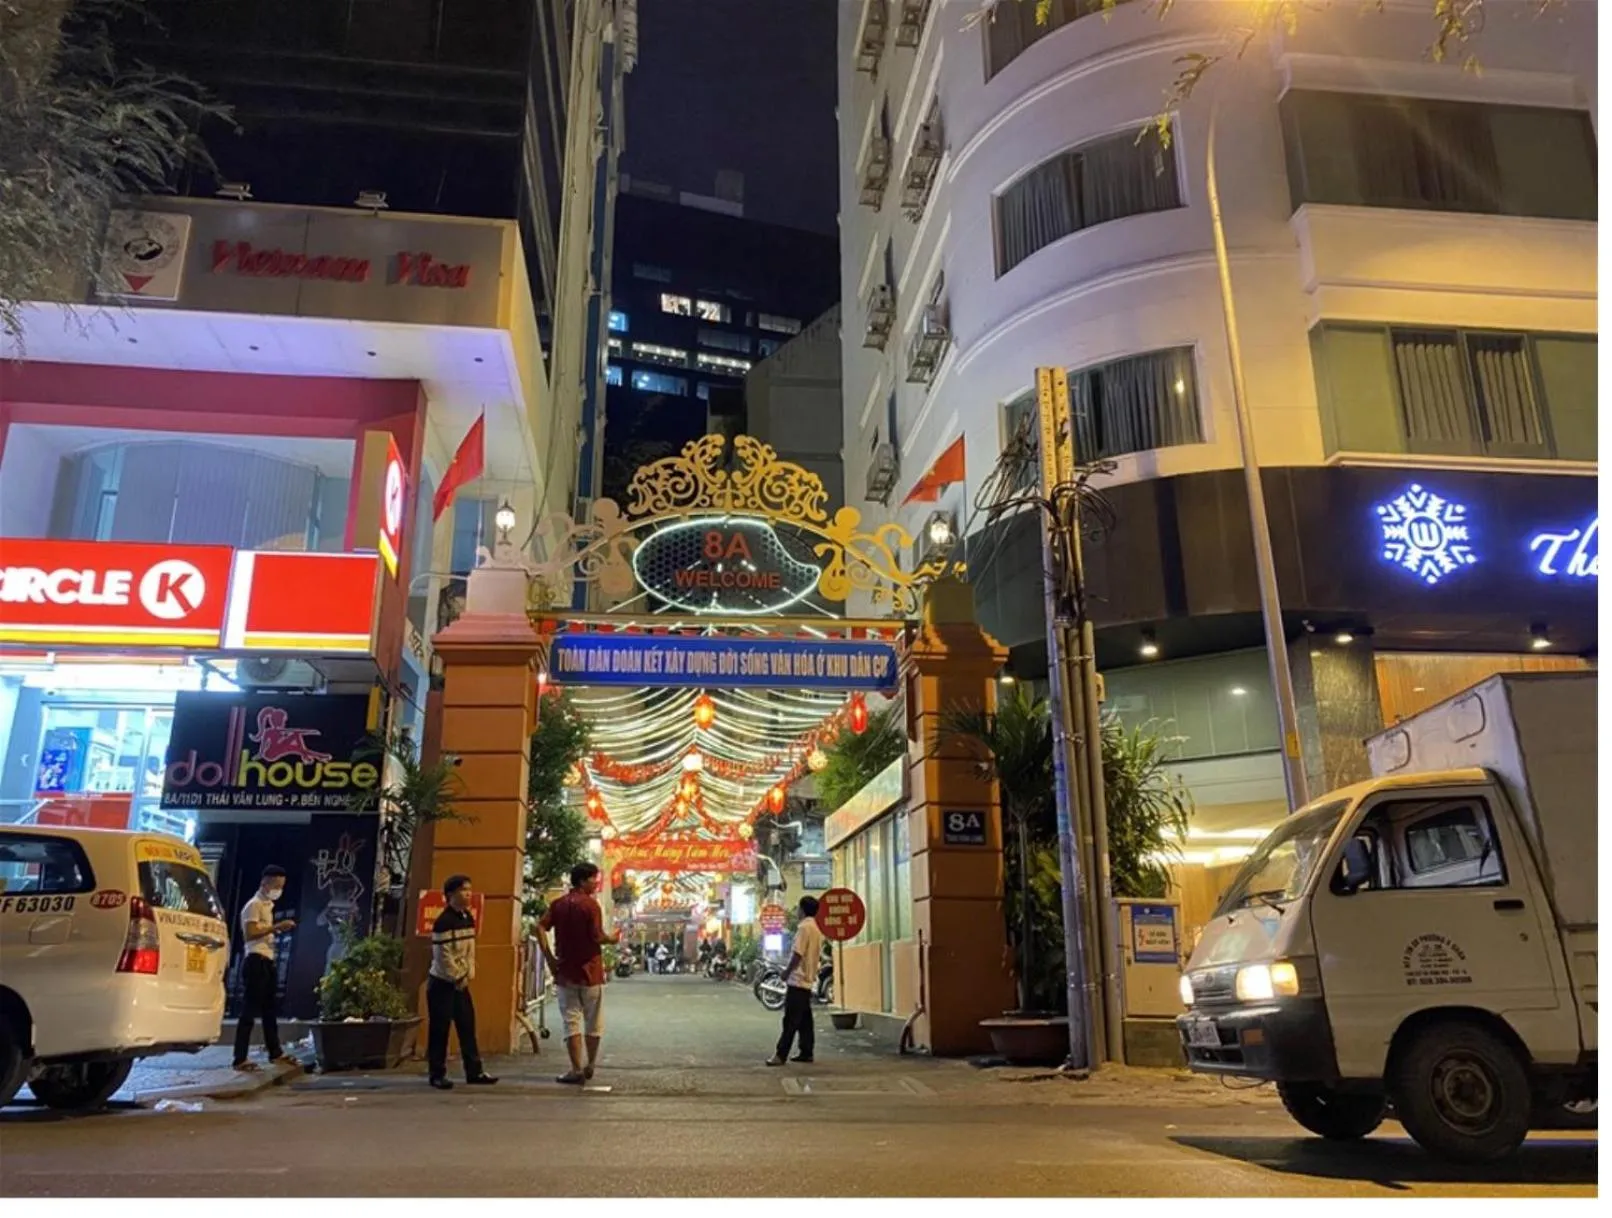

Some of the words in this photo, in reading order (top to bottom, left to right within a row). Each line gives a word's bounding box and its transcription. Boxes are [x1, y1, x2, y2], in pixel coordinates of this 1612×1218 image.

[211, 240, 370, 283] Vietnam
[392, 251, 471, 287] Visa
[704, 532, 752, 559] 8A
[675, 571, 780, 589] WELCOME
[558, 644, 586, 672] TOÀN
[826, 653, 849, 678] KHU
[167, 706, 379, 789] dollhouse
[256, 793, 283, 806] LUNG
[949, 813, 981, 831] 8A
[16, 895, 76, 914] 63030
